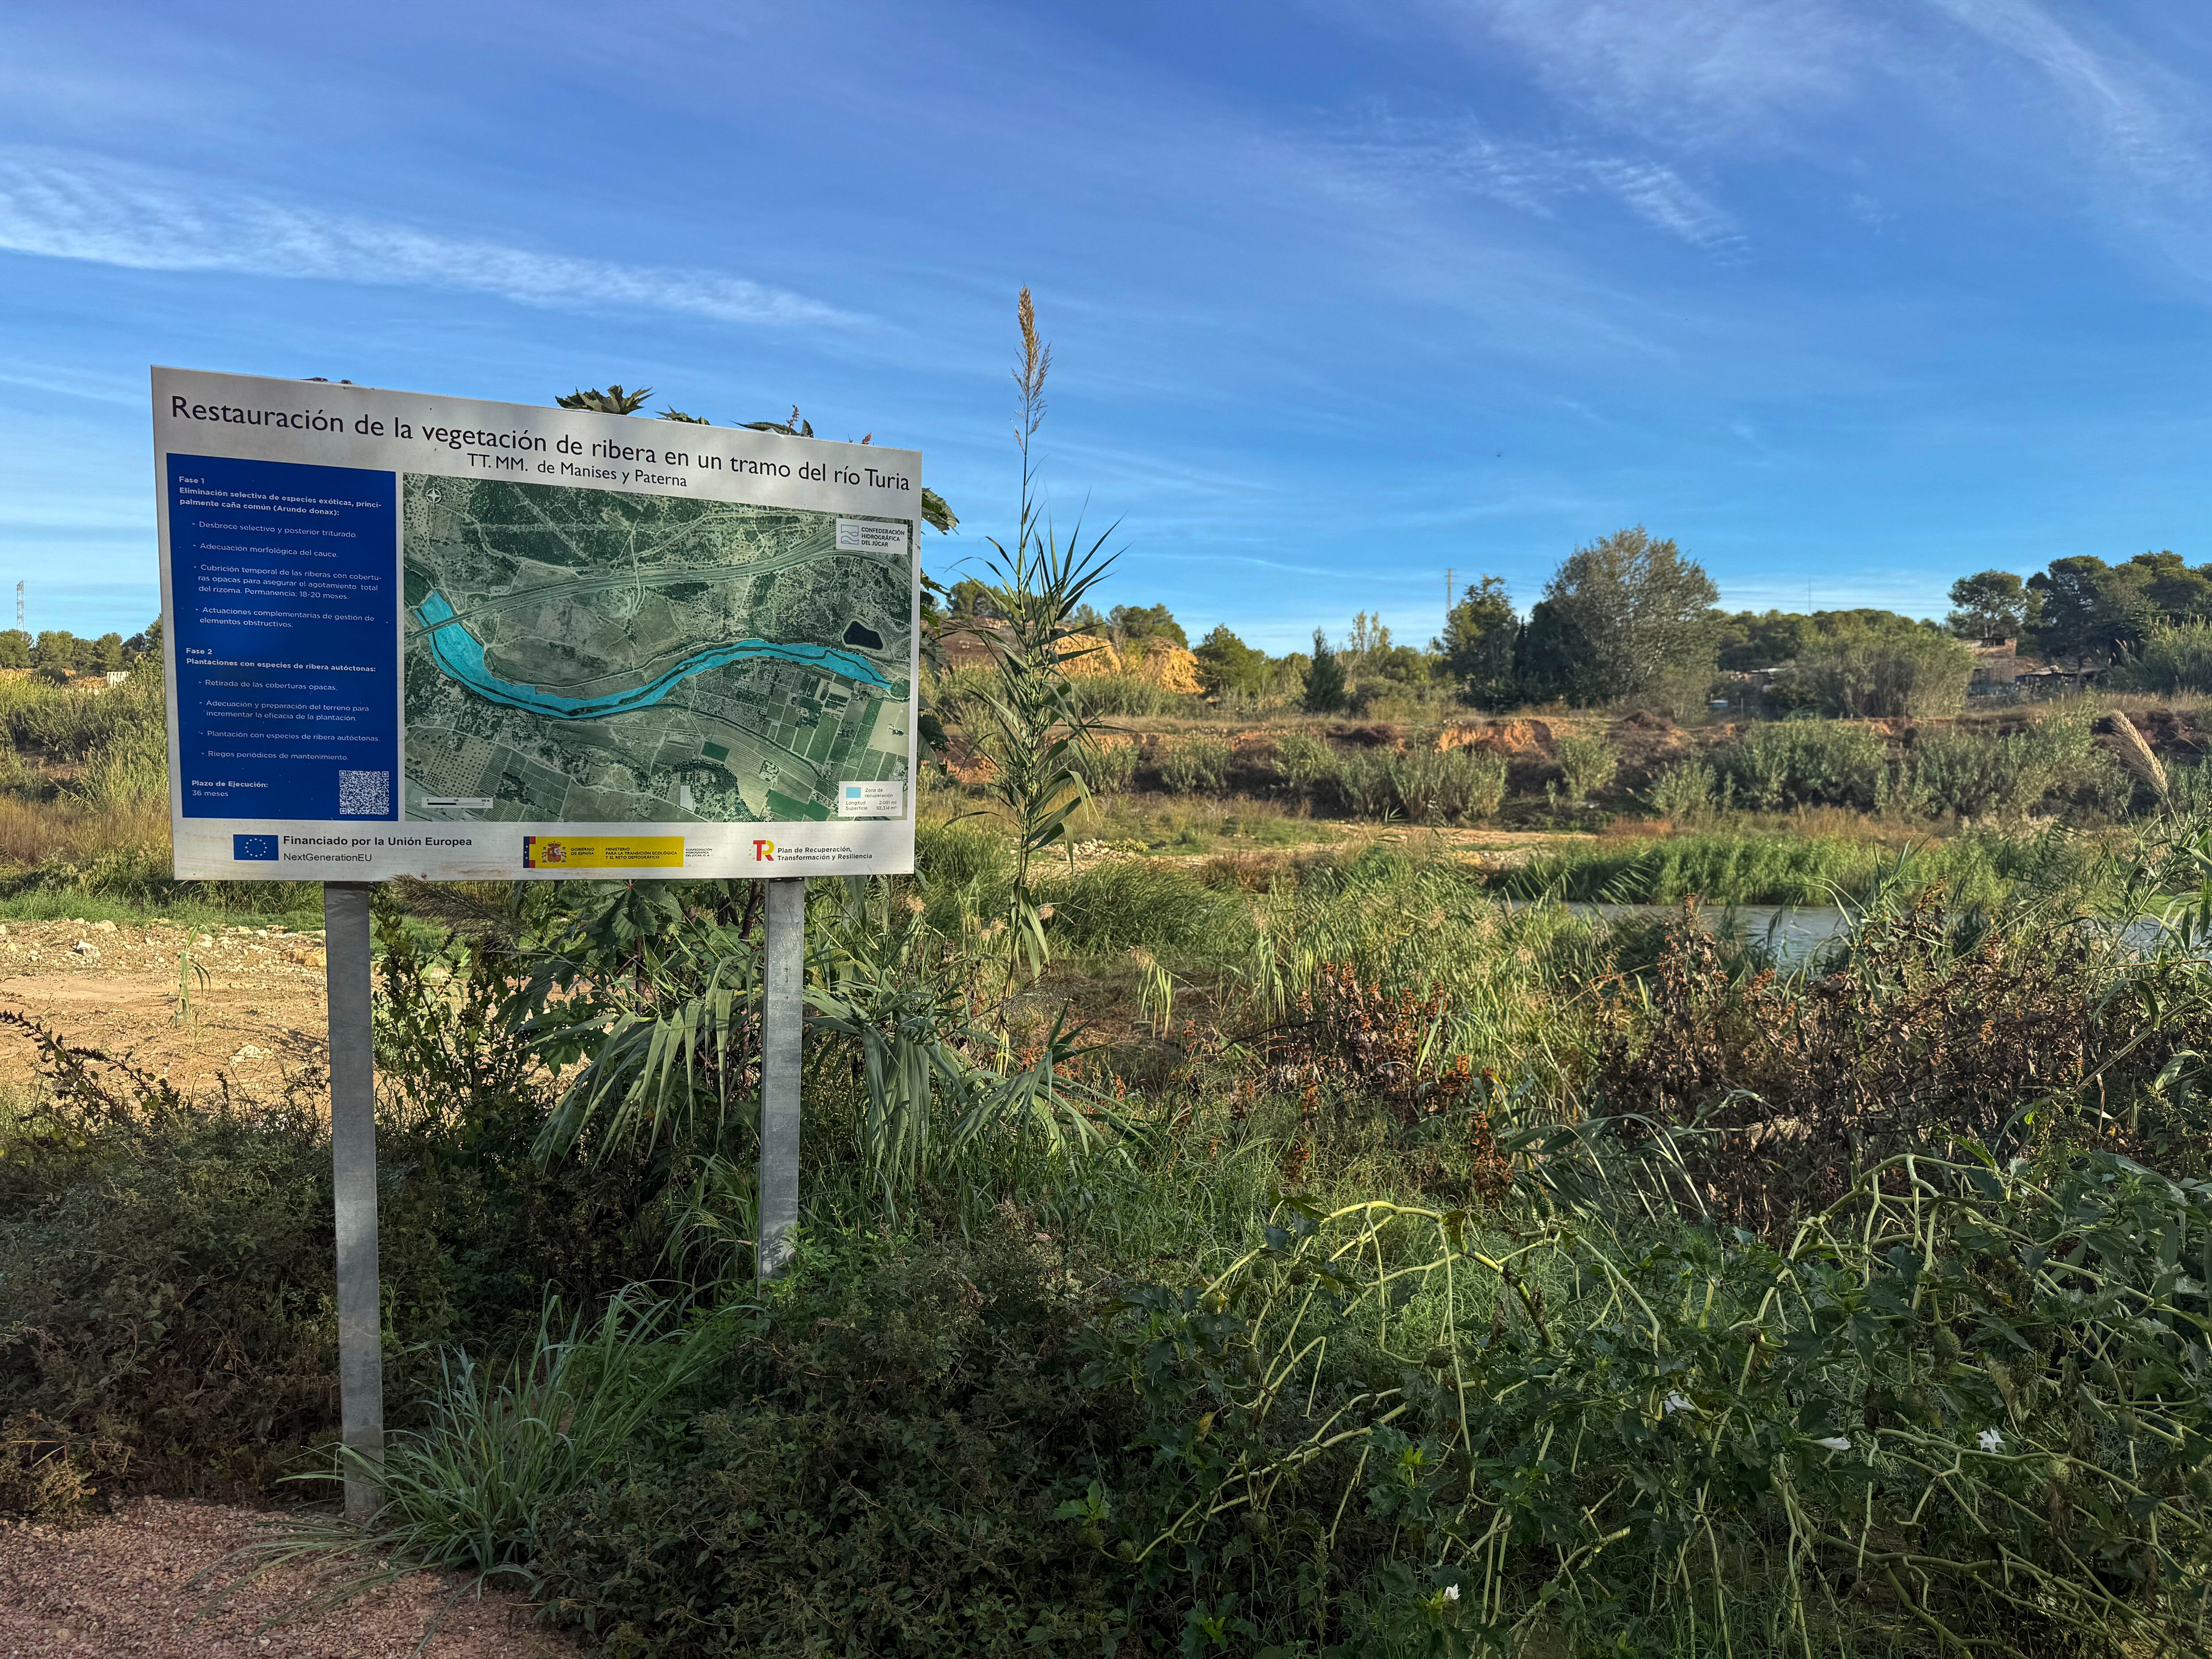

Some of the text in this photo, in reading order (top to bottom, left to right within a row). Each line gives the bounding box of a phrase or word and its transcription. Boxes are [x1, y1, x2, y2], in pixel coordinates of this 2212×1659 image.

[173, 396, 910, 490] Restauración de la vegetación de ribera en un tramo del río Turia
[538, 460, 554, 473] de
[561, 462, 616, 479] Manises
[622, 472, 630, 484] y
[636, 469, 687, 487] Paterna
[180, 487, 228, 496] Eliminación
[284, 836, 347, 845] Financiado
[426, 837, 472, 847] Europea
